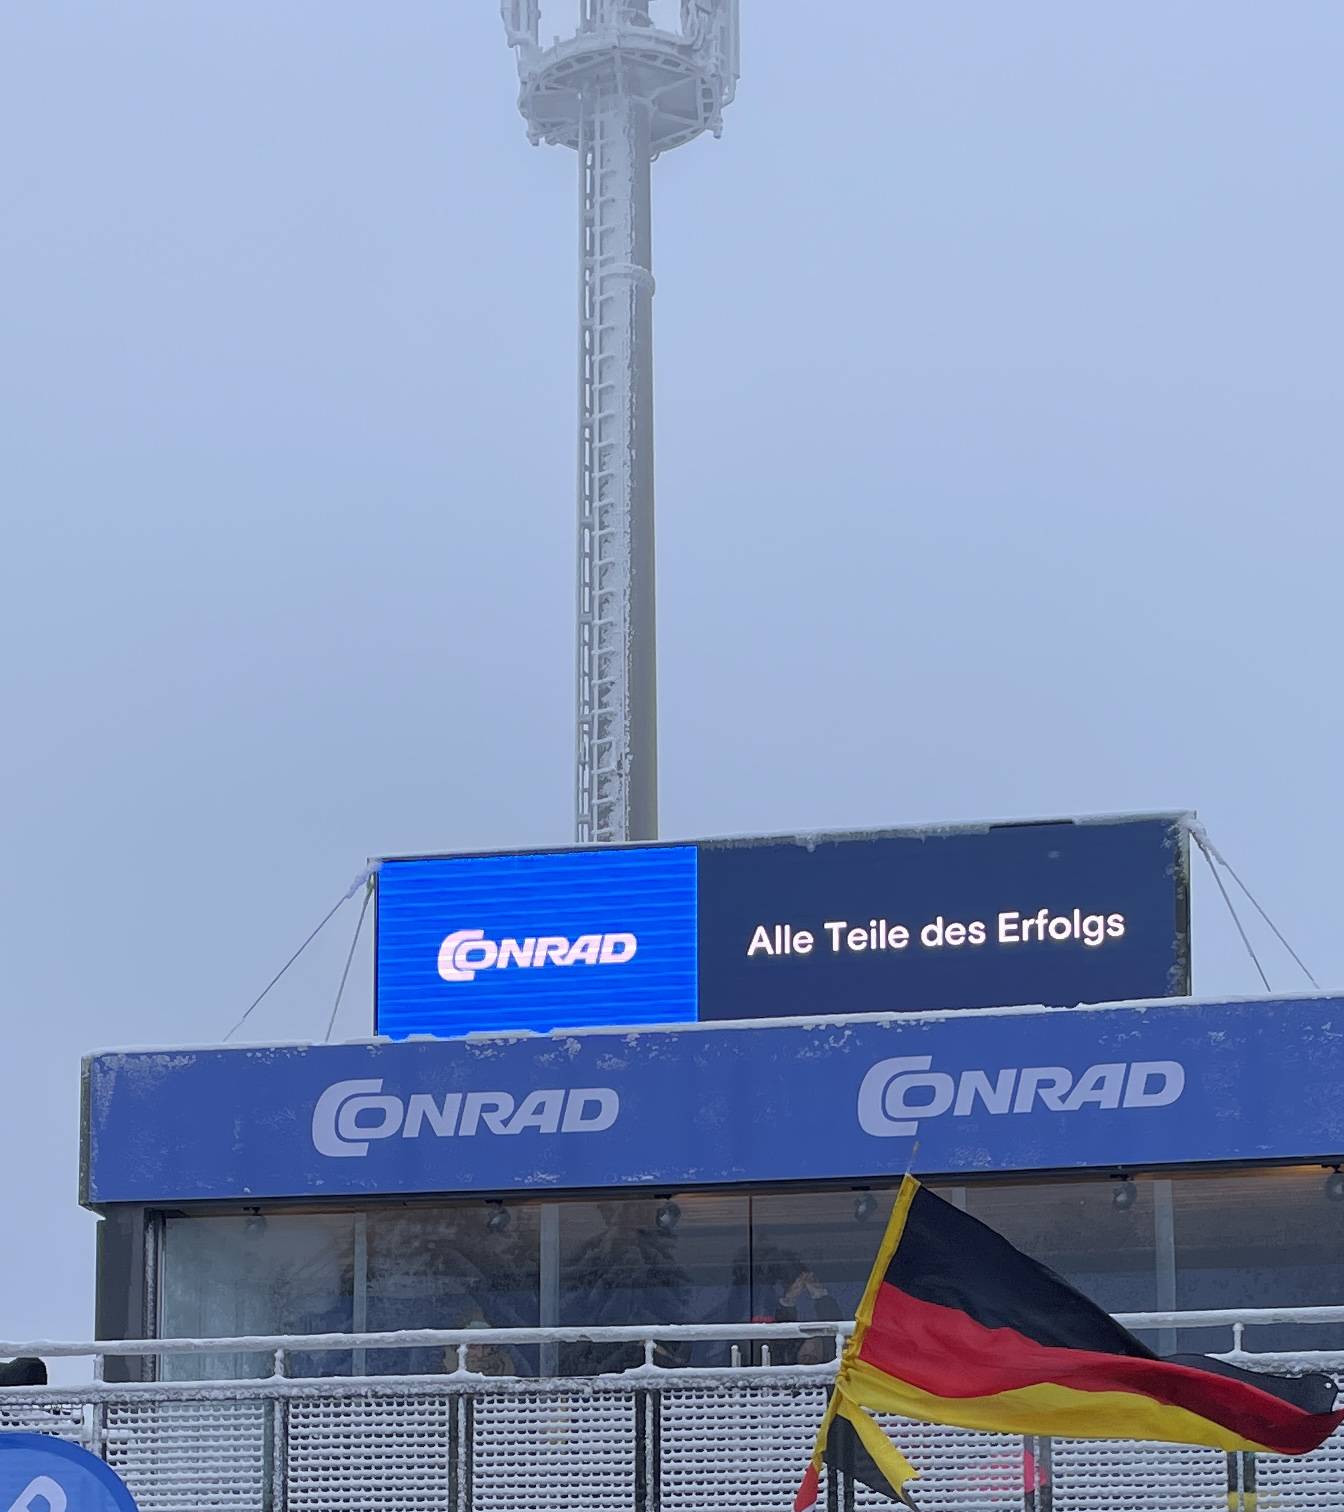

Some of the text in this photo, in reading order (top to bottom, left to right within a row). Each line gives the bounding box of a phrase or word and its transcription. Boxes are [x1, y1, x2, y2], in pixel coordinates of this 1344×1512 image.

[437, 929, 637, 982] CONRAD
[746, 908, 1125, 956] Alle Teile des Erfolgs
[312, 1078, 620, 1157] CONRAD
[857, 1055, 1185, 1137] CONRAD
